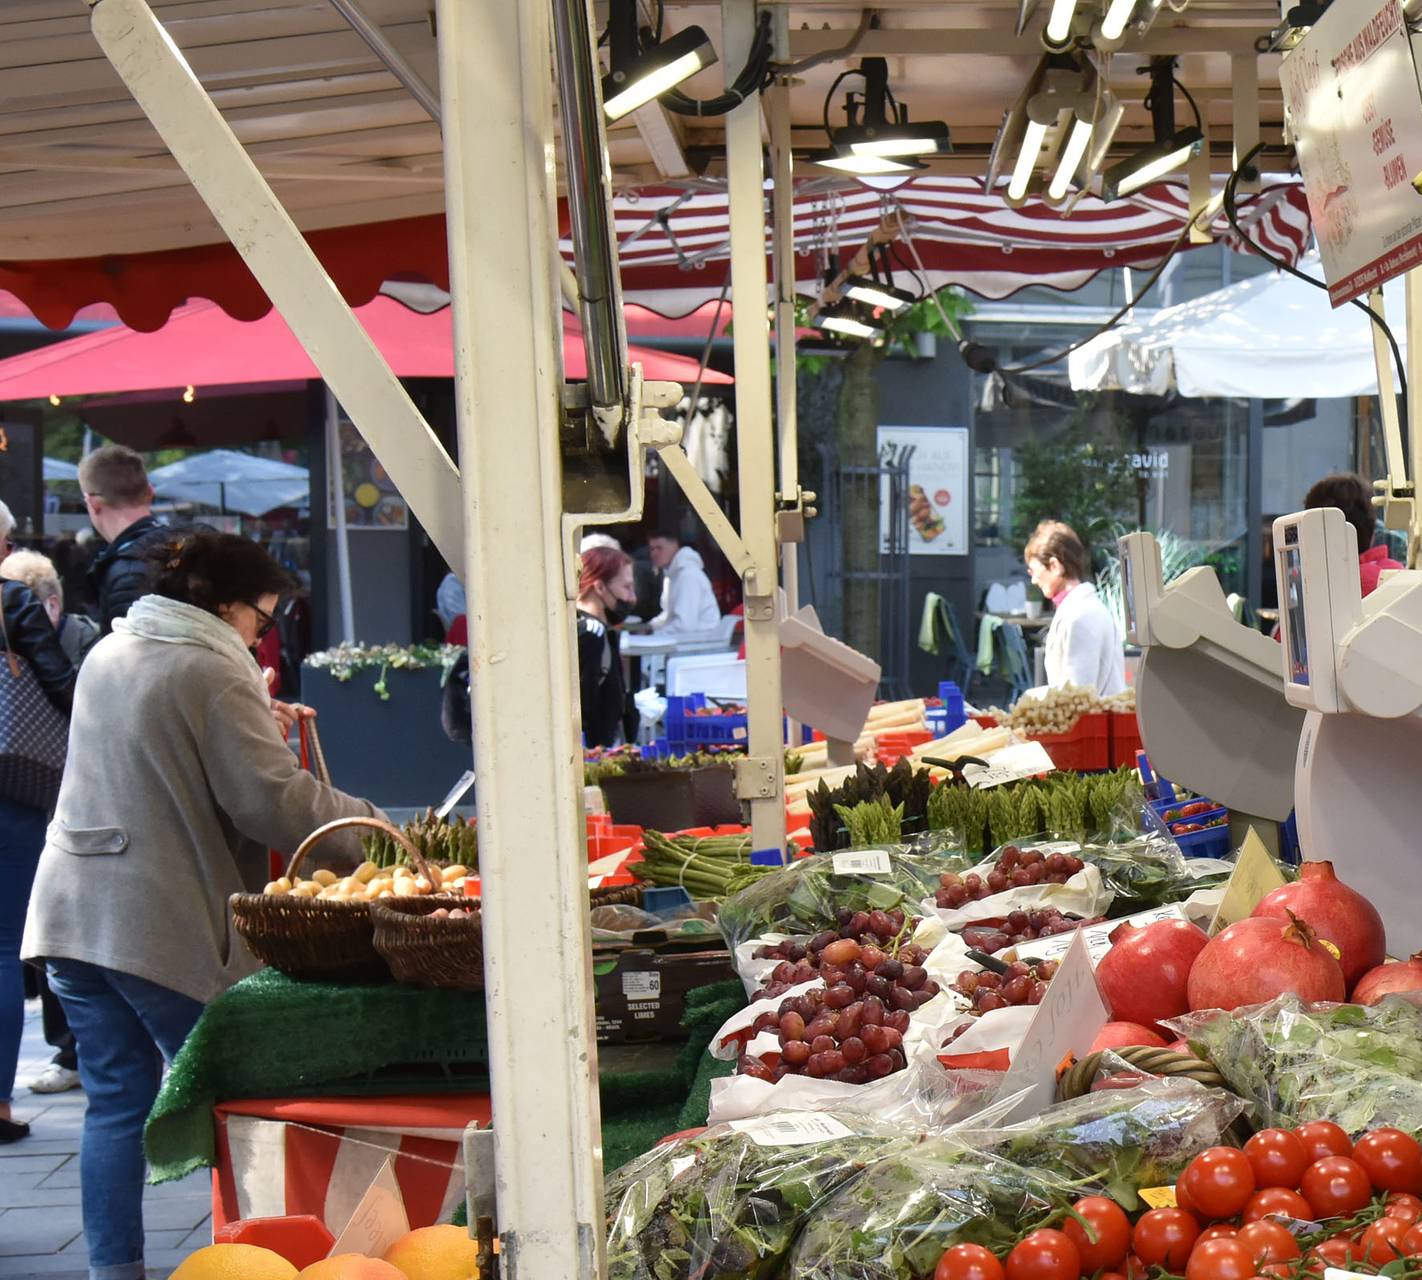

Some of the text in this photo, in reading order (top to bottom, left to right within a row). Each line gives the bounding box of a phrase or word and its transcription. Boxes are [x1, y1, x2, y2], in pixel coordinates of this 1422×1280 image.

[1128, 452, 1168, 468] avid
[649, 980, 660, 990] 60
[627, 1002, 661, 1011] SELECTED
[634, 1011, 655, 1019] LIMES
